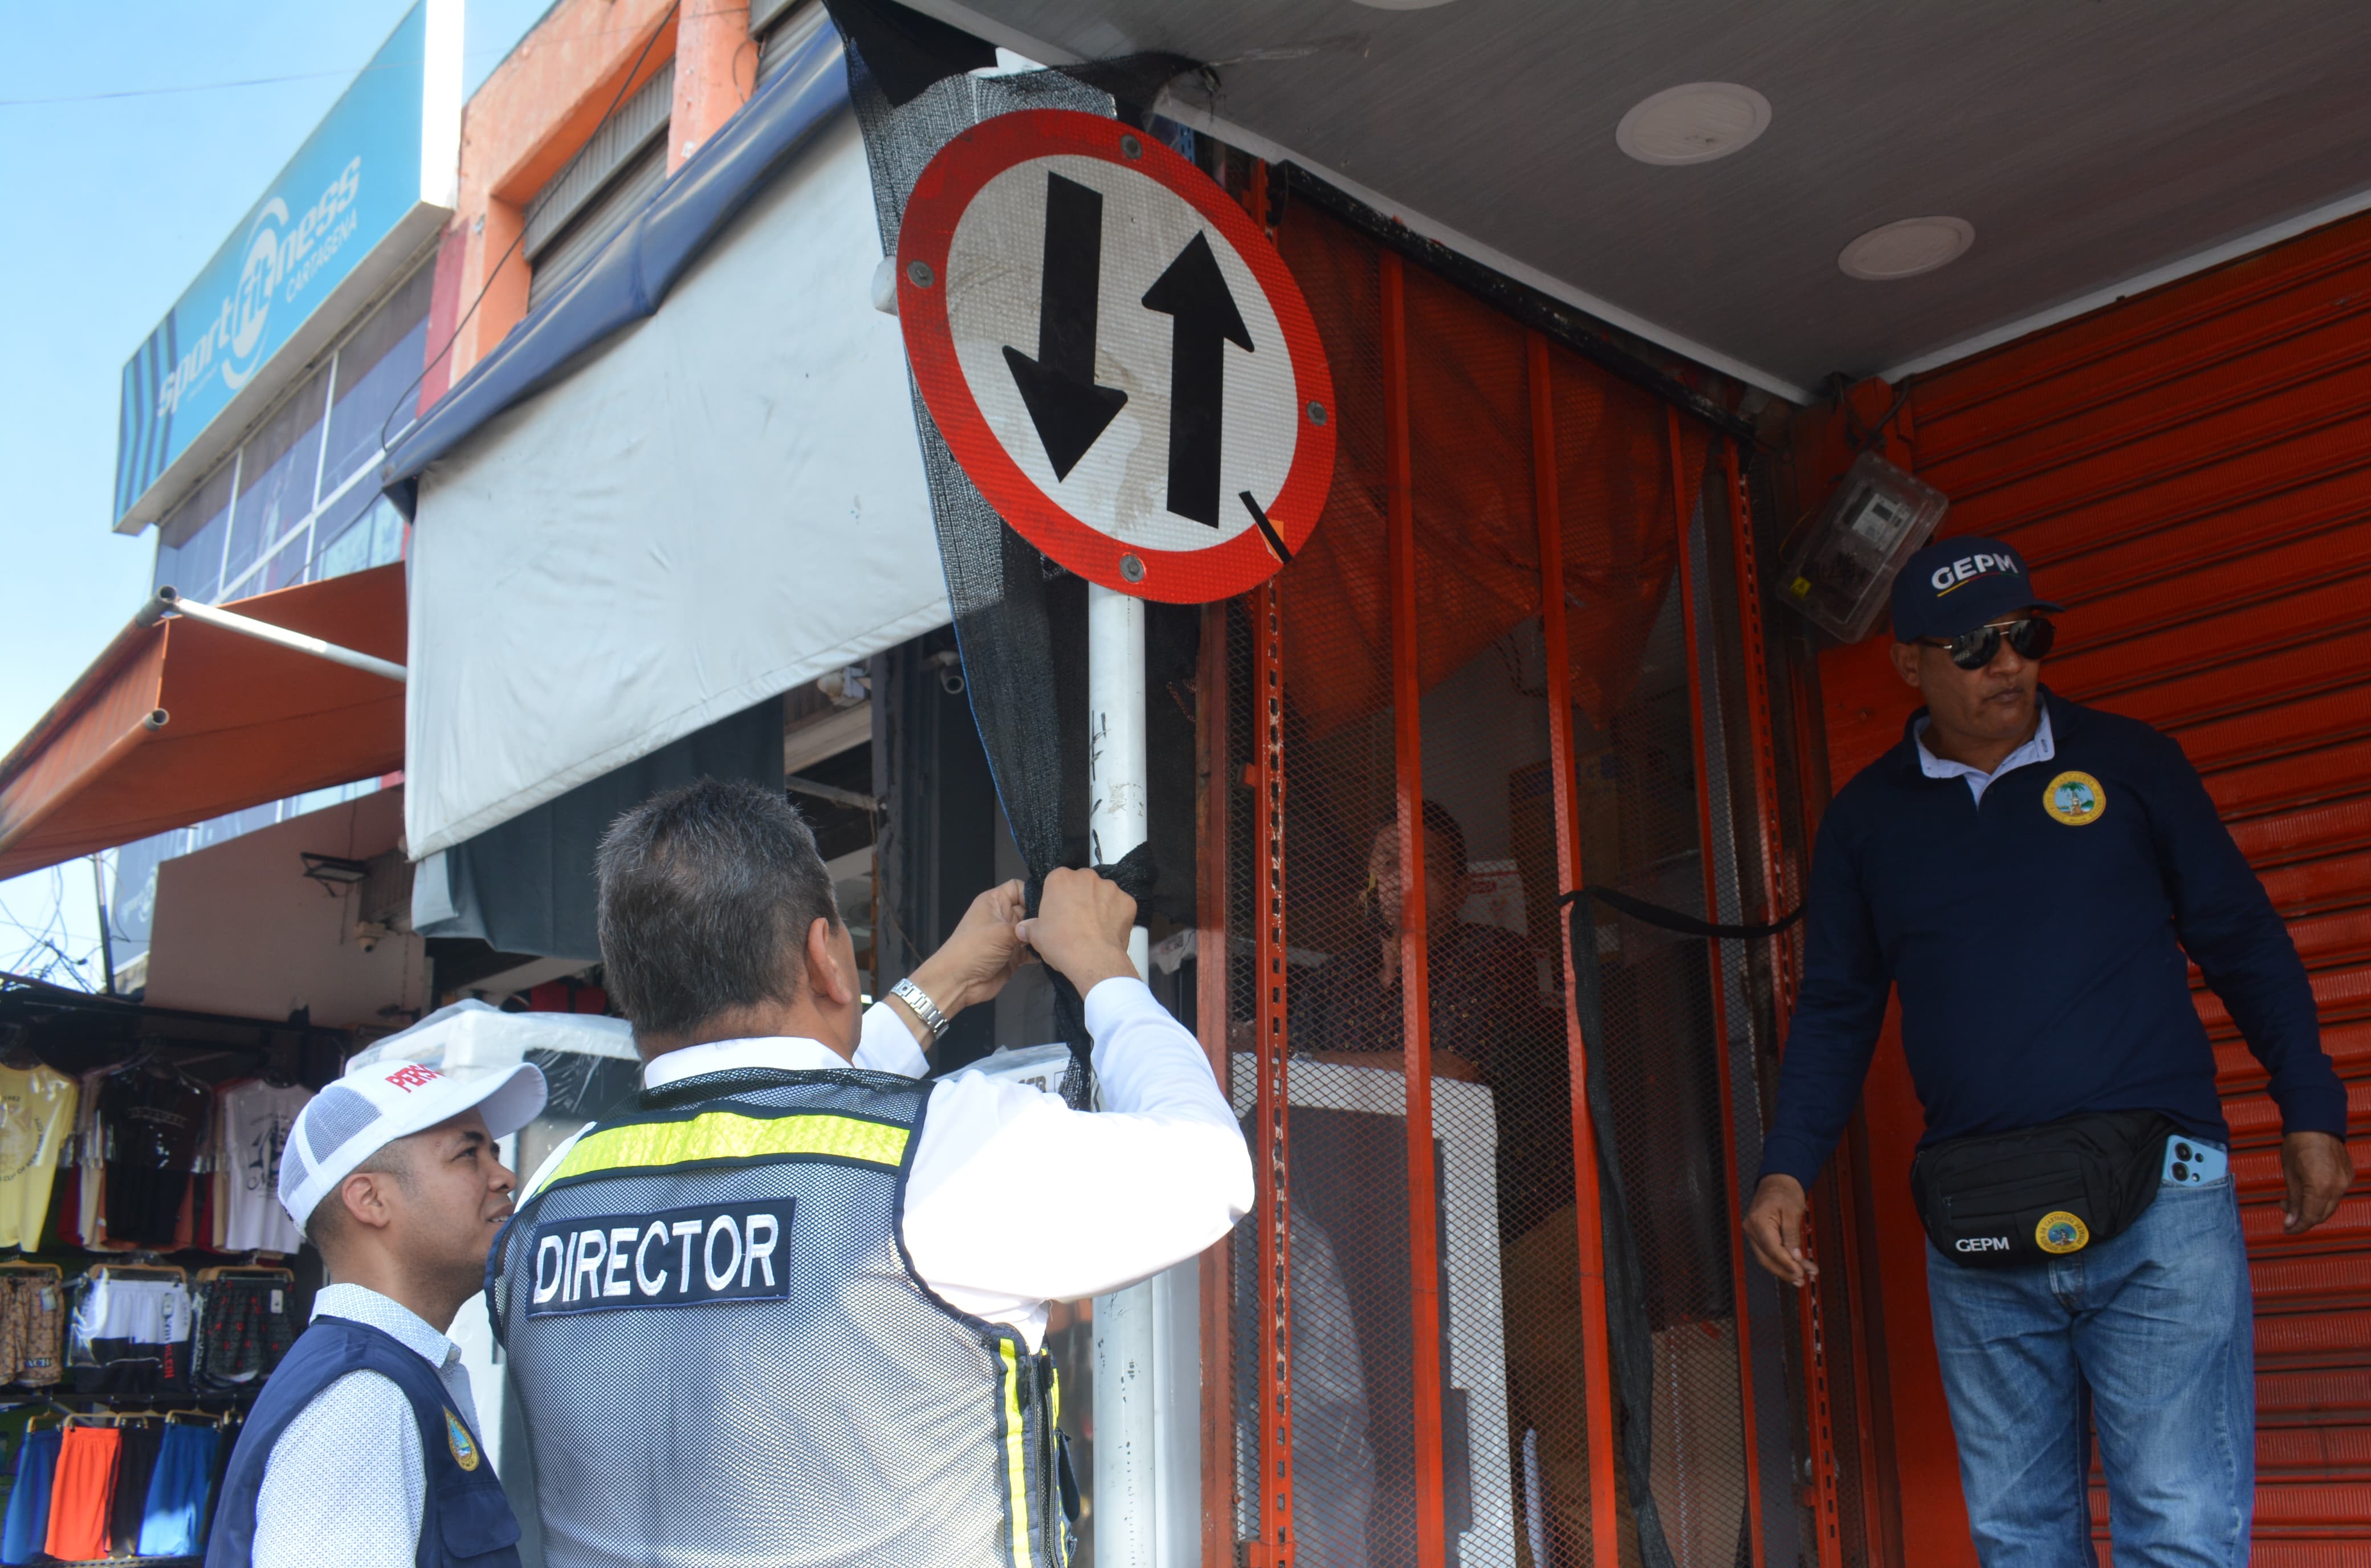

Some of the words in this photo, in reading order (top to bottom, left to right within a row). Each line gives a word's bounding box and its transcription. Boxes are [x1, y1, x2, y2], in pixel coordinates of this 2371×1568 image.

[286, 207, 357, 303] CARTAGENA
[1932, 553, 2019, 589] GEPM
[533, 1213, 779, 1304] DIRECTOR
[1956, 1236, 2010, 1252] GEPM
